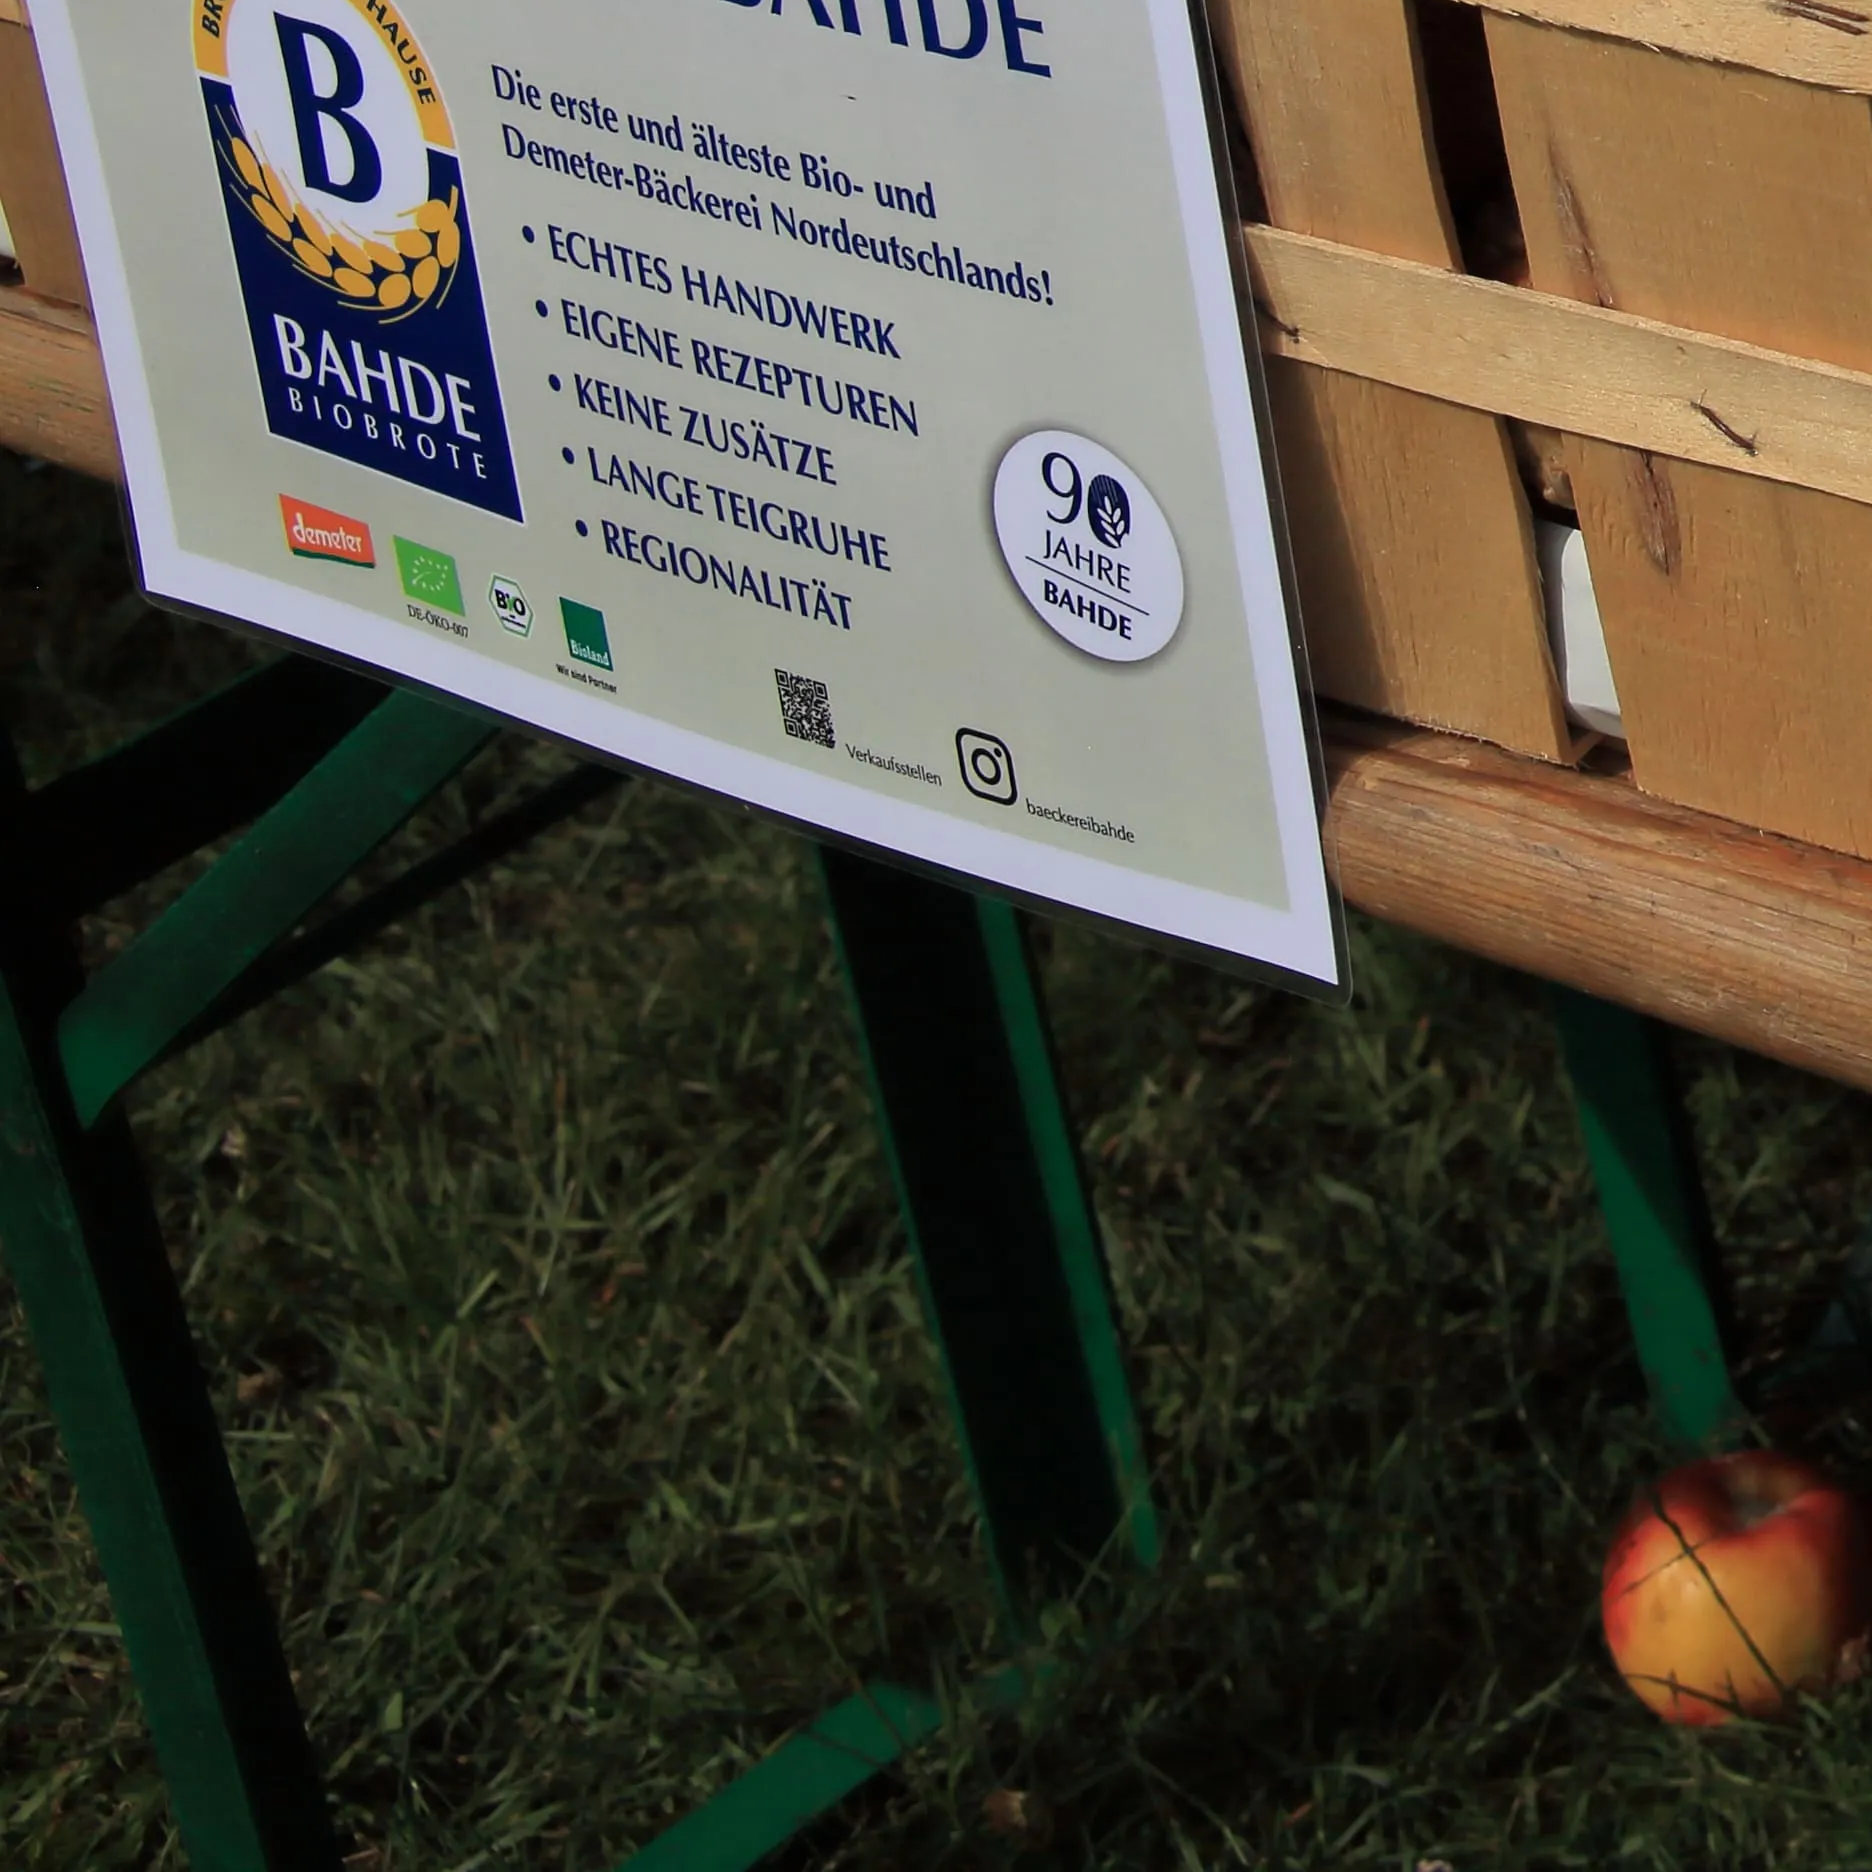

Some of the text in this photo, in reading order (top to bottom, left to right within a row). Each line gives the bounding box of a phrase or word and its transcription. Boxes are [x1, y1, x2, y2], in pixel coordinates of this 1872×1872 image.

[273, 10, 383, 203] B
[492, 64, 936, 221] Die erste und älteste Bio- und
[502, 123, 1055, 306] Demeter-Bäckerei Nordeutschlands!
[548, 225, 901, 359] ECHTES HANDWERK
[273, 313, 482, 442] BAHDE
[561, 298, 919, 438] EIGENE REZEPTUREN
[289, 387, 488, 480] BIOBROTE
[575, 372, 838, 486] KEINE ZUSÄTZE
[292, 512, 363, 554] demeter
[587, 447, 893, 573] LANGE TEIGRUHE
[1042, 534, 1131, 594] JAHRE
[407, 604, 470, 639] DE-ÖKO-007
[602, 518, 852, 631] REGIONALITÄT
[1042, 579, 1133, 641] BAHDE
[570, 639, 610, 666] Bioland
[847, 743, 942, 788] Verkaufsstellen
[1026, 798, 1136, 844] baeckereibahde
